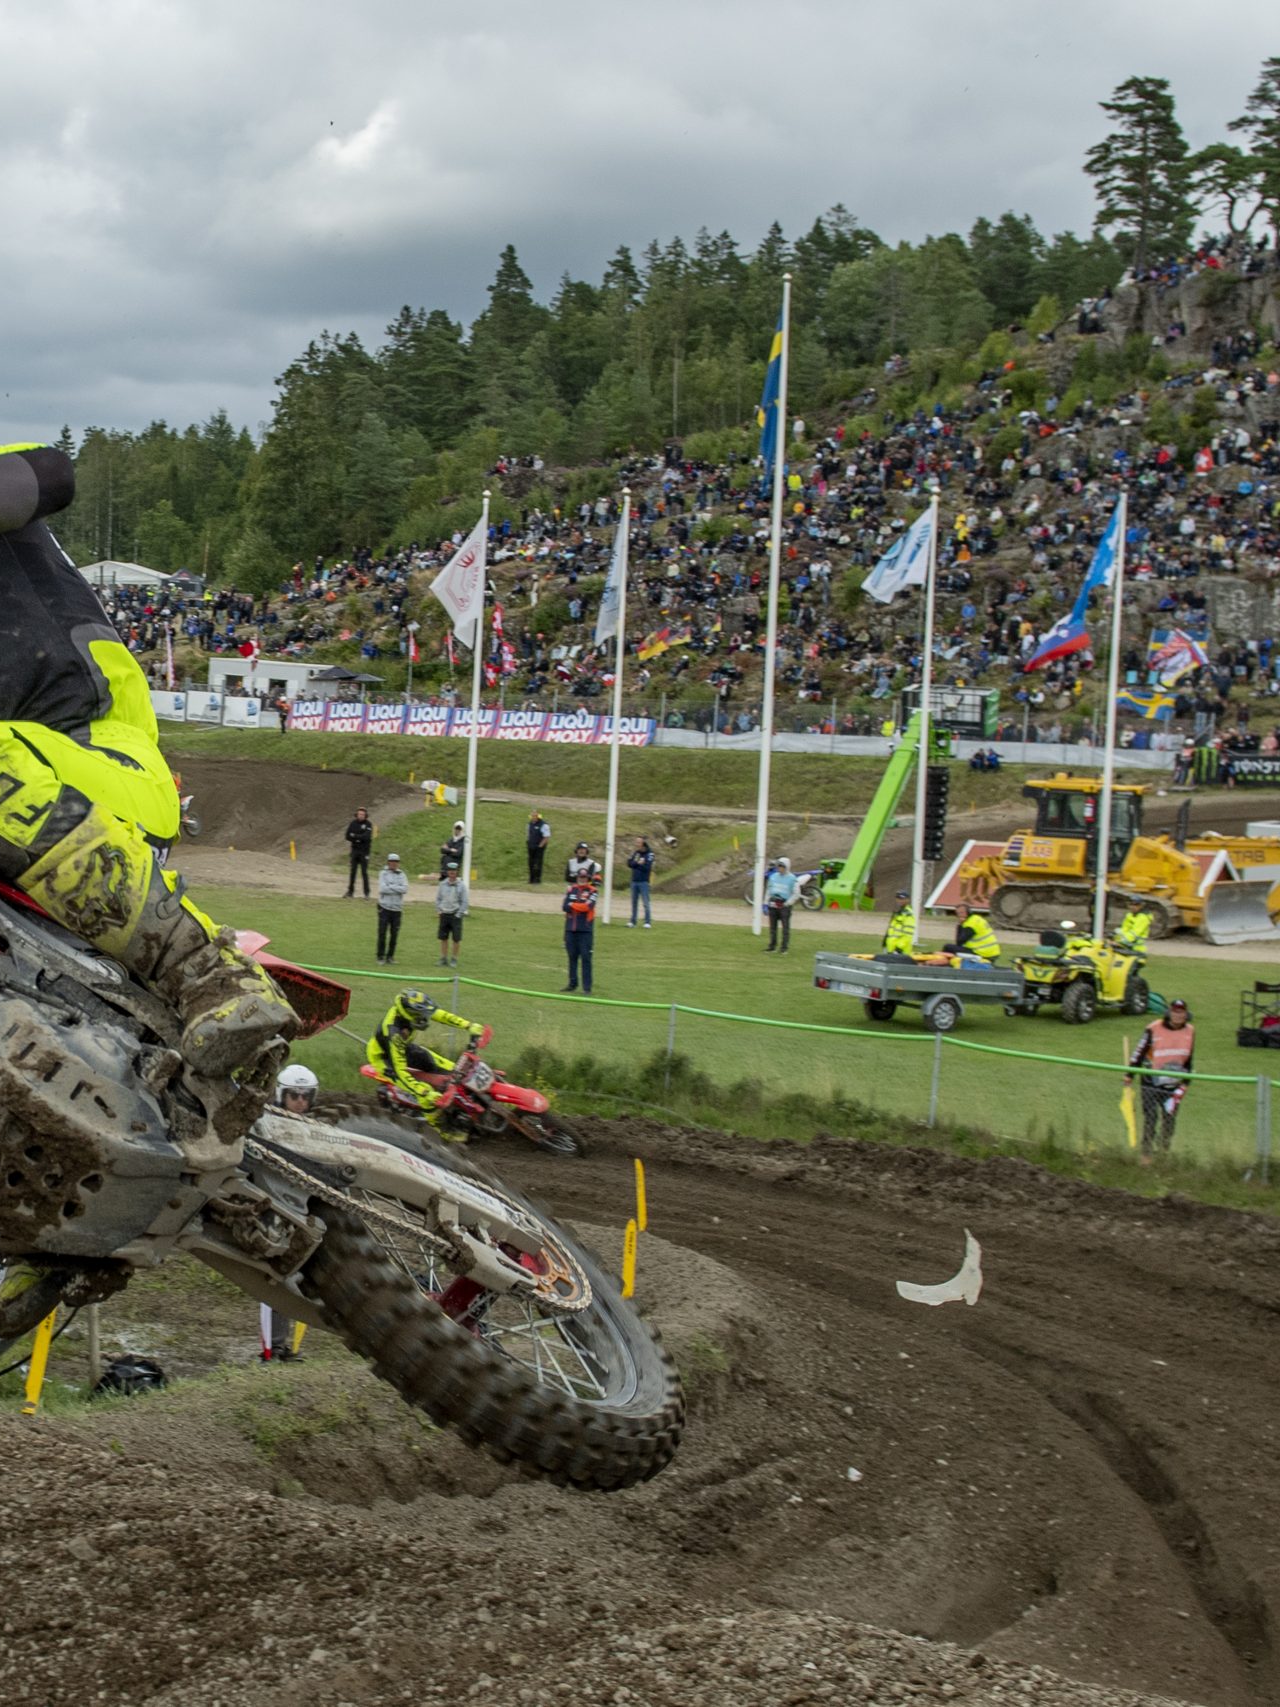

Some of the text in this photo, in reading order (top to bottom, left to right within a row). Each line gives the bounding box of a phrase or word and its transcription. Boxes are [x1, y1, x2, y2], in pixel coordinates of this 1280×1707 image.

[293, 702, 323, 716] LIQUI
[330, 703, 362, 718] LIQUI
[370, 704, 402, 720] LIQUI
[410, 706, 447, 722] LIQUI
[291, 716, 322, 730] MOLY
[327, 718, 362, 733] MOLY
[501, 711, 543, 727] LIQUI
[550, 713, 594, 729] LIQUI
[604, 716, 648, 733] LQUI
[366, 720, 401, 734] MOLY
[406, 722, 447, 736] MOLY
[497, 726, 540, 740] MOLY
[547, 729, 592, 743] MOLY
